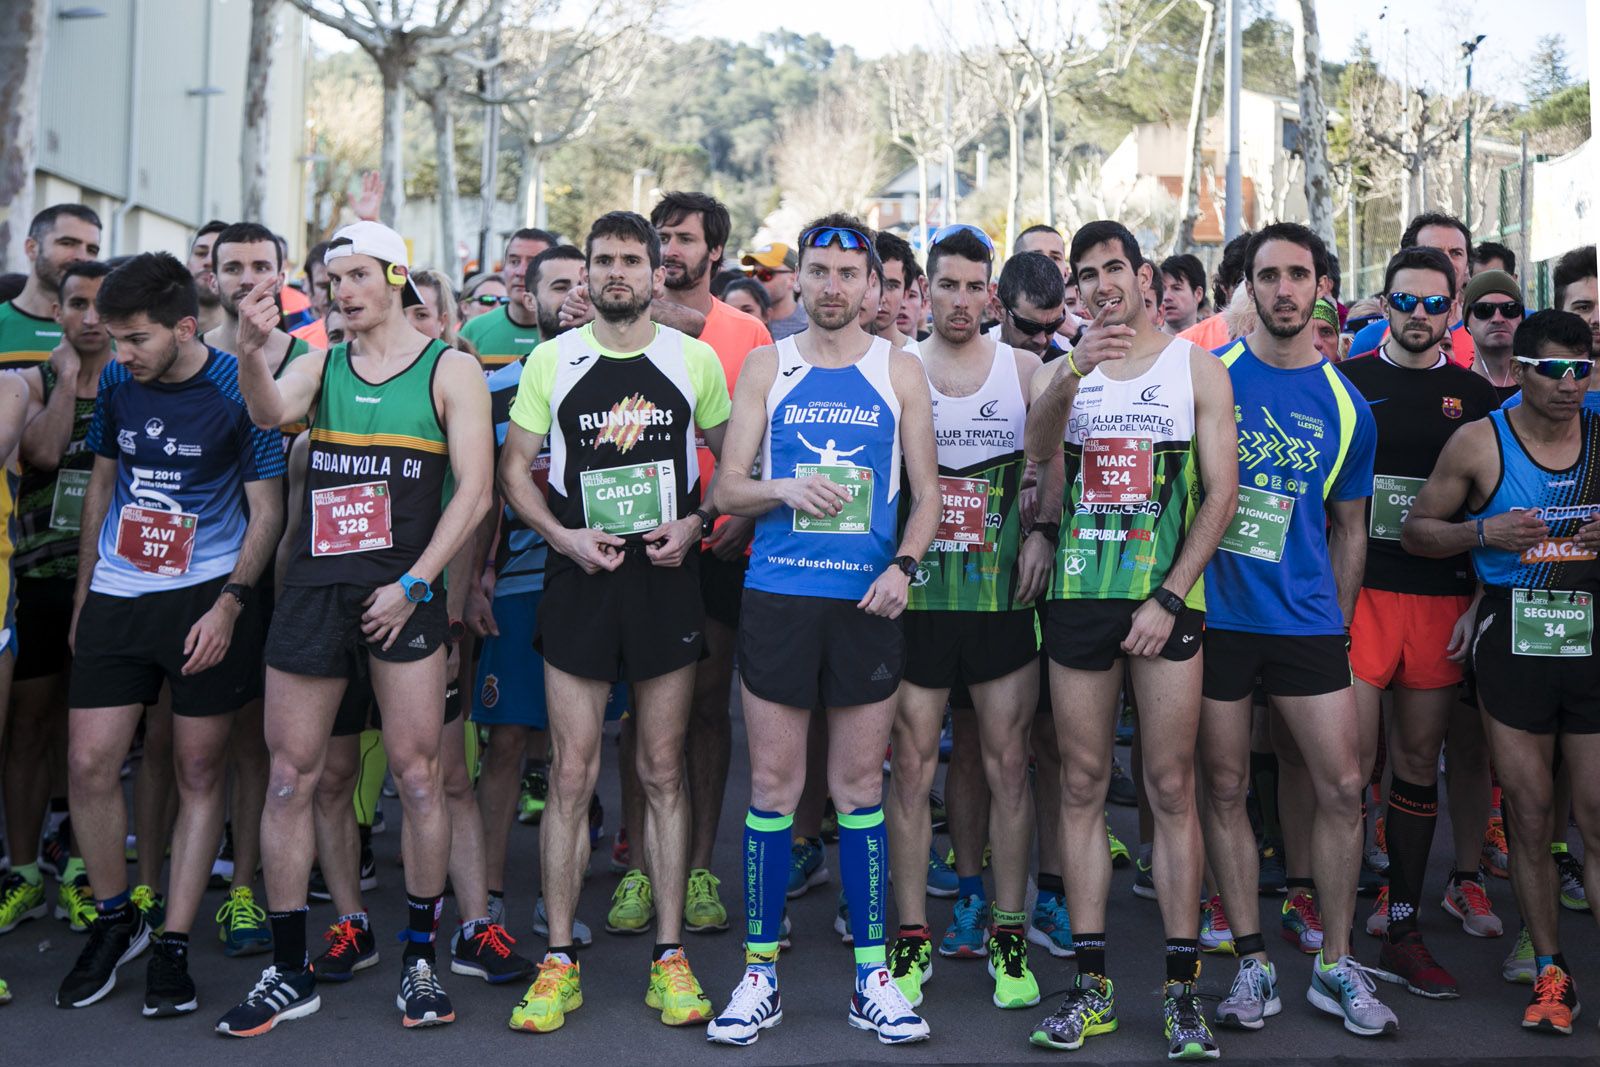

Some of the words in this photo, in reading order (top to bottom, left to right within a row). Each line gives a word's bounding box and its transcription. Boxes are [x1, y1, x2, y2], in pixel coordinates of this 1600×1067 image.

[579, 409, 673, 432] RUNNERS
[1125, 414, 1174, 428] TRIATLO
[965, 429, 1015, 440] TRIATLO
[1120, 424, 1137, 432] DEL
[1138, 424, 1174, 436] VALLES
[978, 439, 1014, 448] VALLES
[402, 458, 422, 479] CH
[1096, 454, 1137, 468] MARC
[154, 470, 182, 481] 2016
[1101, 470, 1131, 486] 324
[596, 481, 652, 501] CARLOS
[332, 501, 374, 519] MARC
[616, 499, 634, 516] 17
[1246, 507, 1285, 524] IGNACIO
[140, 525, 176, 542] XAVI
[337, 517, 369, 535] 328
[1238, 521, 1260, 539] 22
[142, 541, 169, 558] 317
[767, 555, 874, 572] www.duscholux.es
[1523, 607, 1586, 620] SEGUNDO
[1544, 622, 1566, 638] 34
